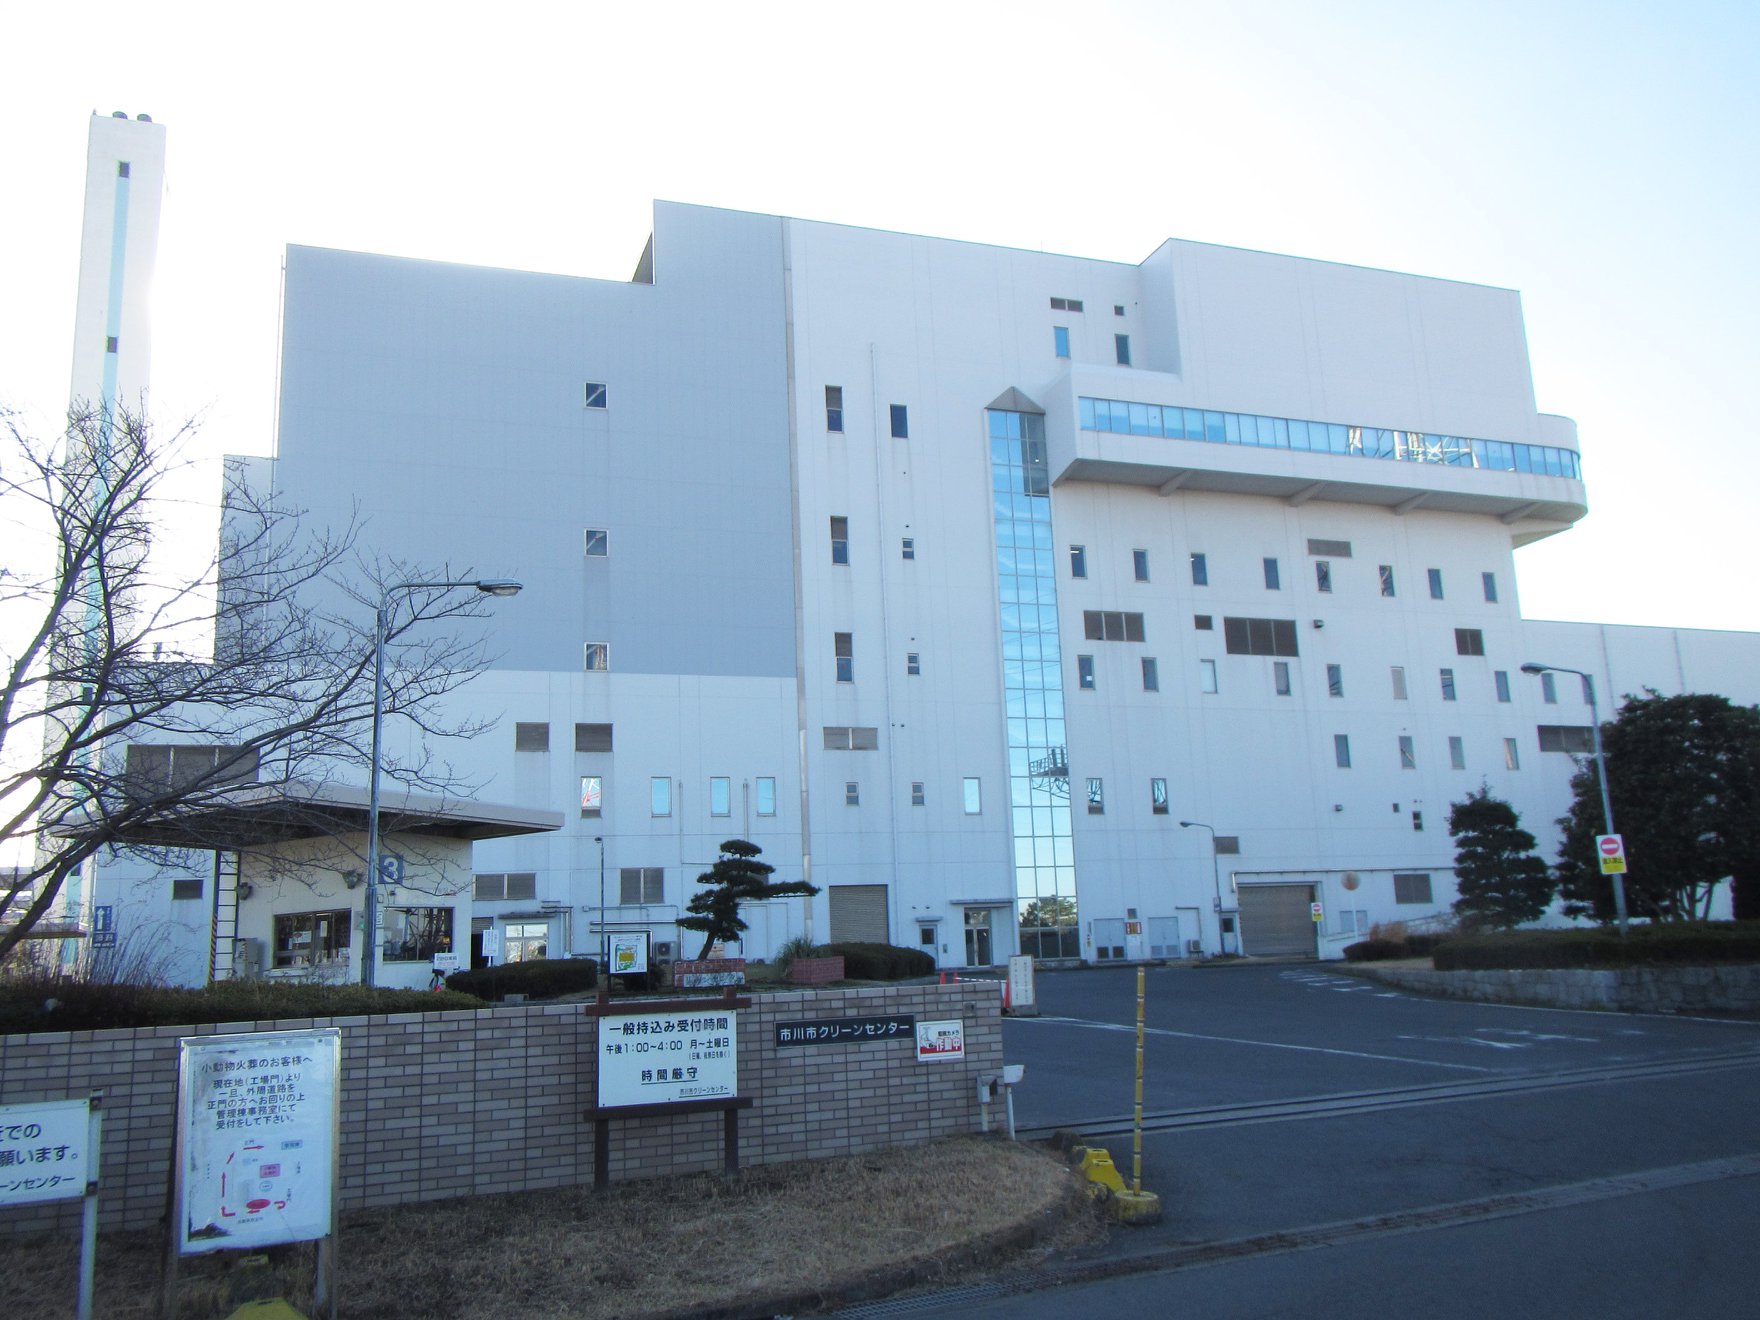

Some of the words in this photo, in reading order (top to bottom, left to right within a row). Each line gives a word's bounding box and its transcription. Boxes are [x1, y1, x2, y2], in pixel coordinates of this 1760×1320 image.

[382, 857, 399, 882] 3
[609, 1017, 729, 1036] 一般持込み受付時間
[780, 1022, 910, 1041] 市川市クリーンセンター
[201, 1055, 313, 1073] 小動物火葬のお客様へ
[207, 1092, 306, 1110] 正門の方へお回りの上
[216, 1115, 294, 1130] 受付をして下さい。
[0, 1123, 42, 1142] での
